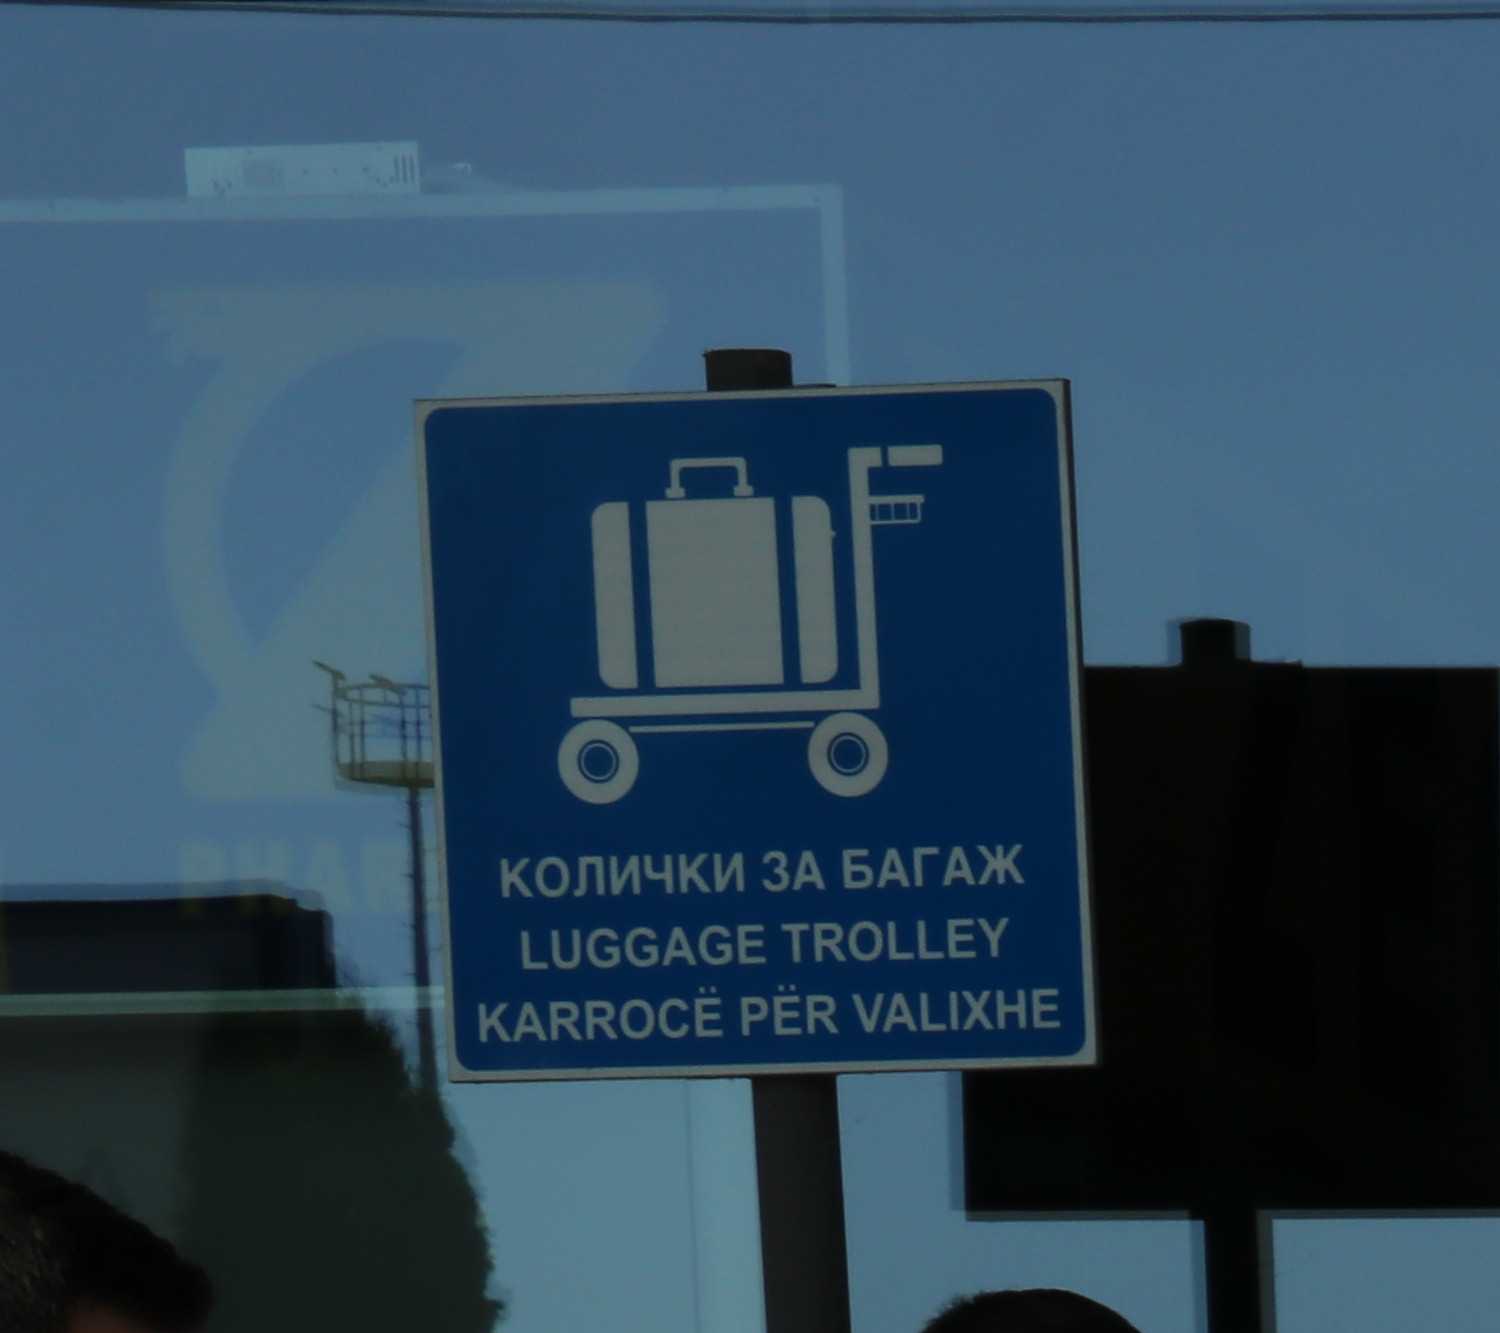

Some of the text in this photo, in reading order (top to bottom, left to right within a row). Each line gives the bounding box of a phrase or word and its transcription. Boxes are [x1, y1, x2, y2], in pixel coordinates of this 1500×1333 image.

[499, 843, 1025, 898] КОЛИЧКИ ЗА БАГАЖ
[520, 918, 1010, 971] LUGGAGE TROLLEY
[477, 985, 1062, 1044] KARROCË PËR VALIXHE
